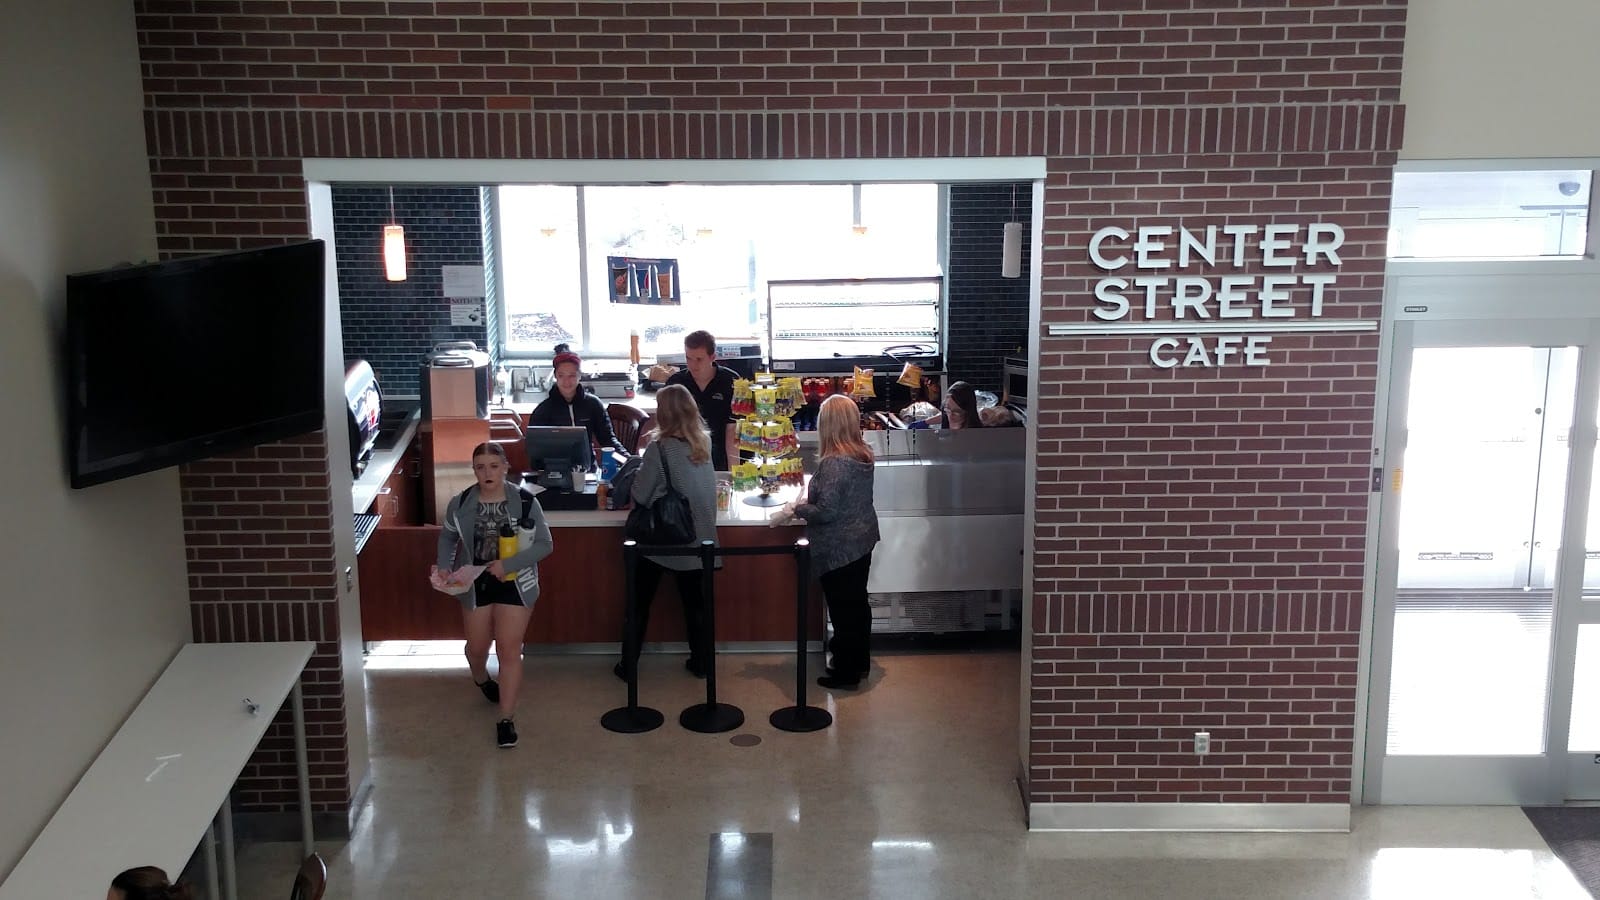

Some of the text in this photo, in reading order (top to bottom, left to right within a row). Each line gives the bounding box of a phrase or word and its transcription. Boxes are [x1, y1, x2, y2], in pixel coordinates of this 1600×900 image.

[1089, 223, 1345, 269] CENTER
[1093, 275, 1336, 320] STREET
[1150, 336, 1272, 368] CAFE
